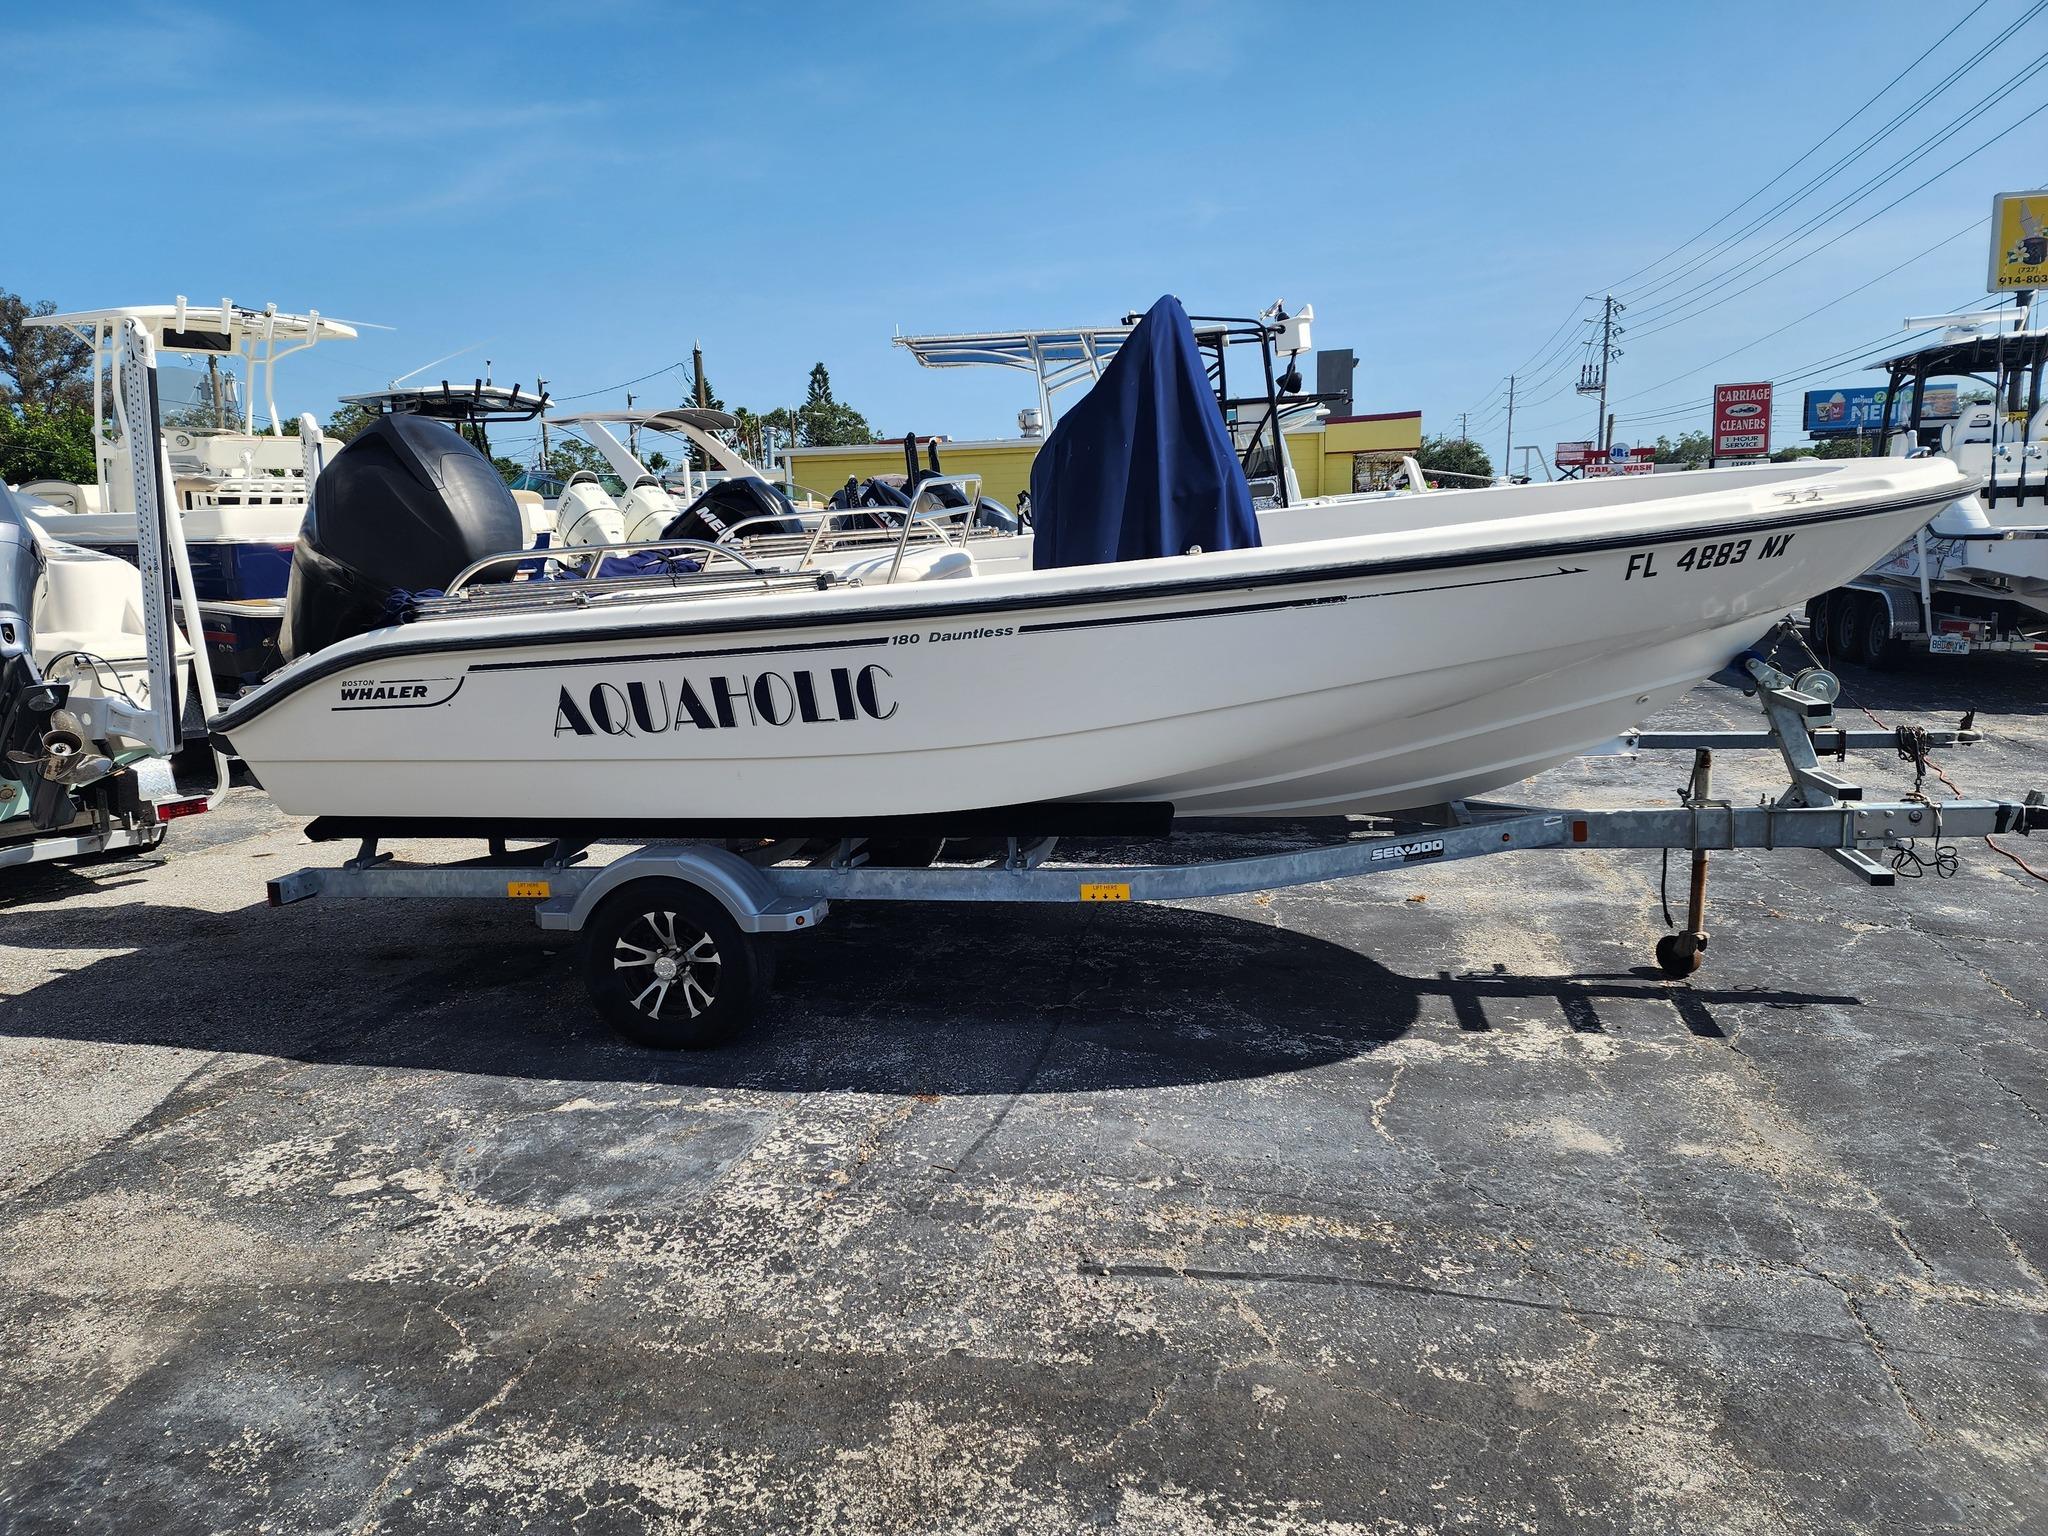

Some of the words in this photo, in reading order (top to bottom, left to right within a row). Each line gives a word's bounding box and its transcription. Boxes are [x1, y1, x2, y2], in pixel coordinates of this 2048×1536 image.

[2018, 266, 2039, 274] (727)
[1720, 388, 1770, 402] CARRIAGE
[1720, 418, 1766, 431] CLEANERS
[1624, 464, 1653, 472] WASH
[1625, 552, 1658, 580] FL
[1677, 539, 1752, 572] 4883
[1757, 533, 1795, 560] NX
[892, 633, 920, 645] 180
[928, 627, 1014, 642] Dauntless
[340, 685, 428, 701] WHALER
[553, 663, 900, 739] AQUAHOLIC
